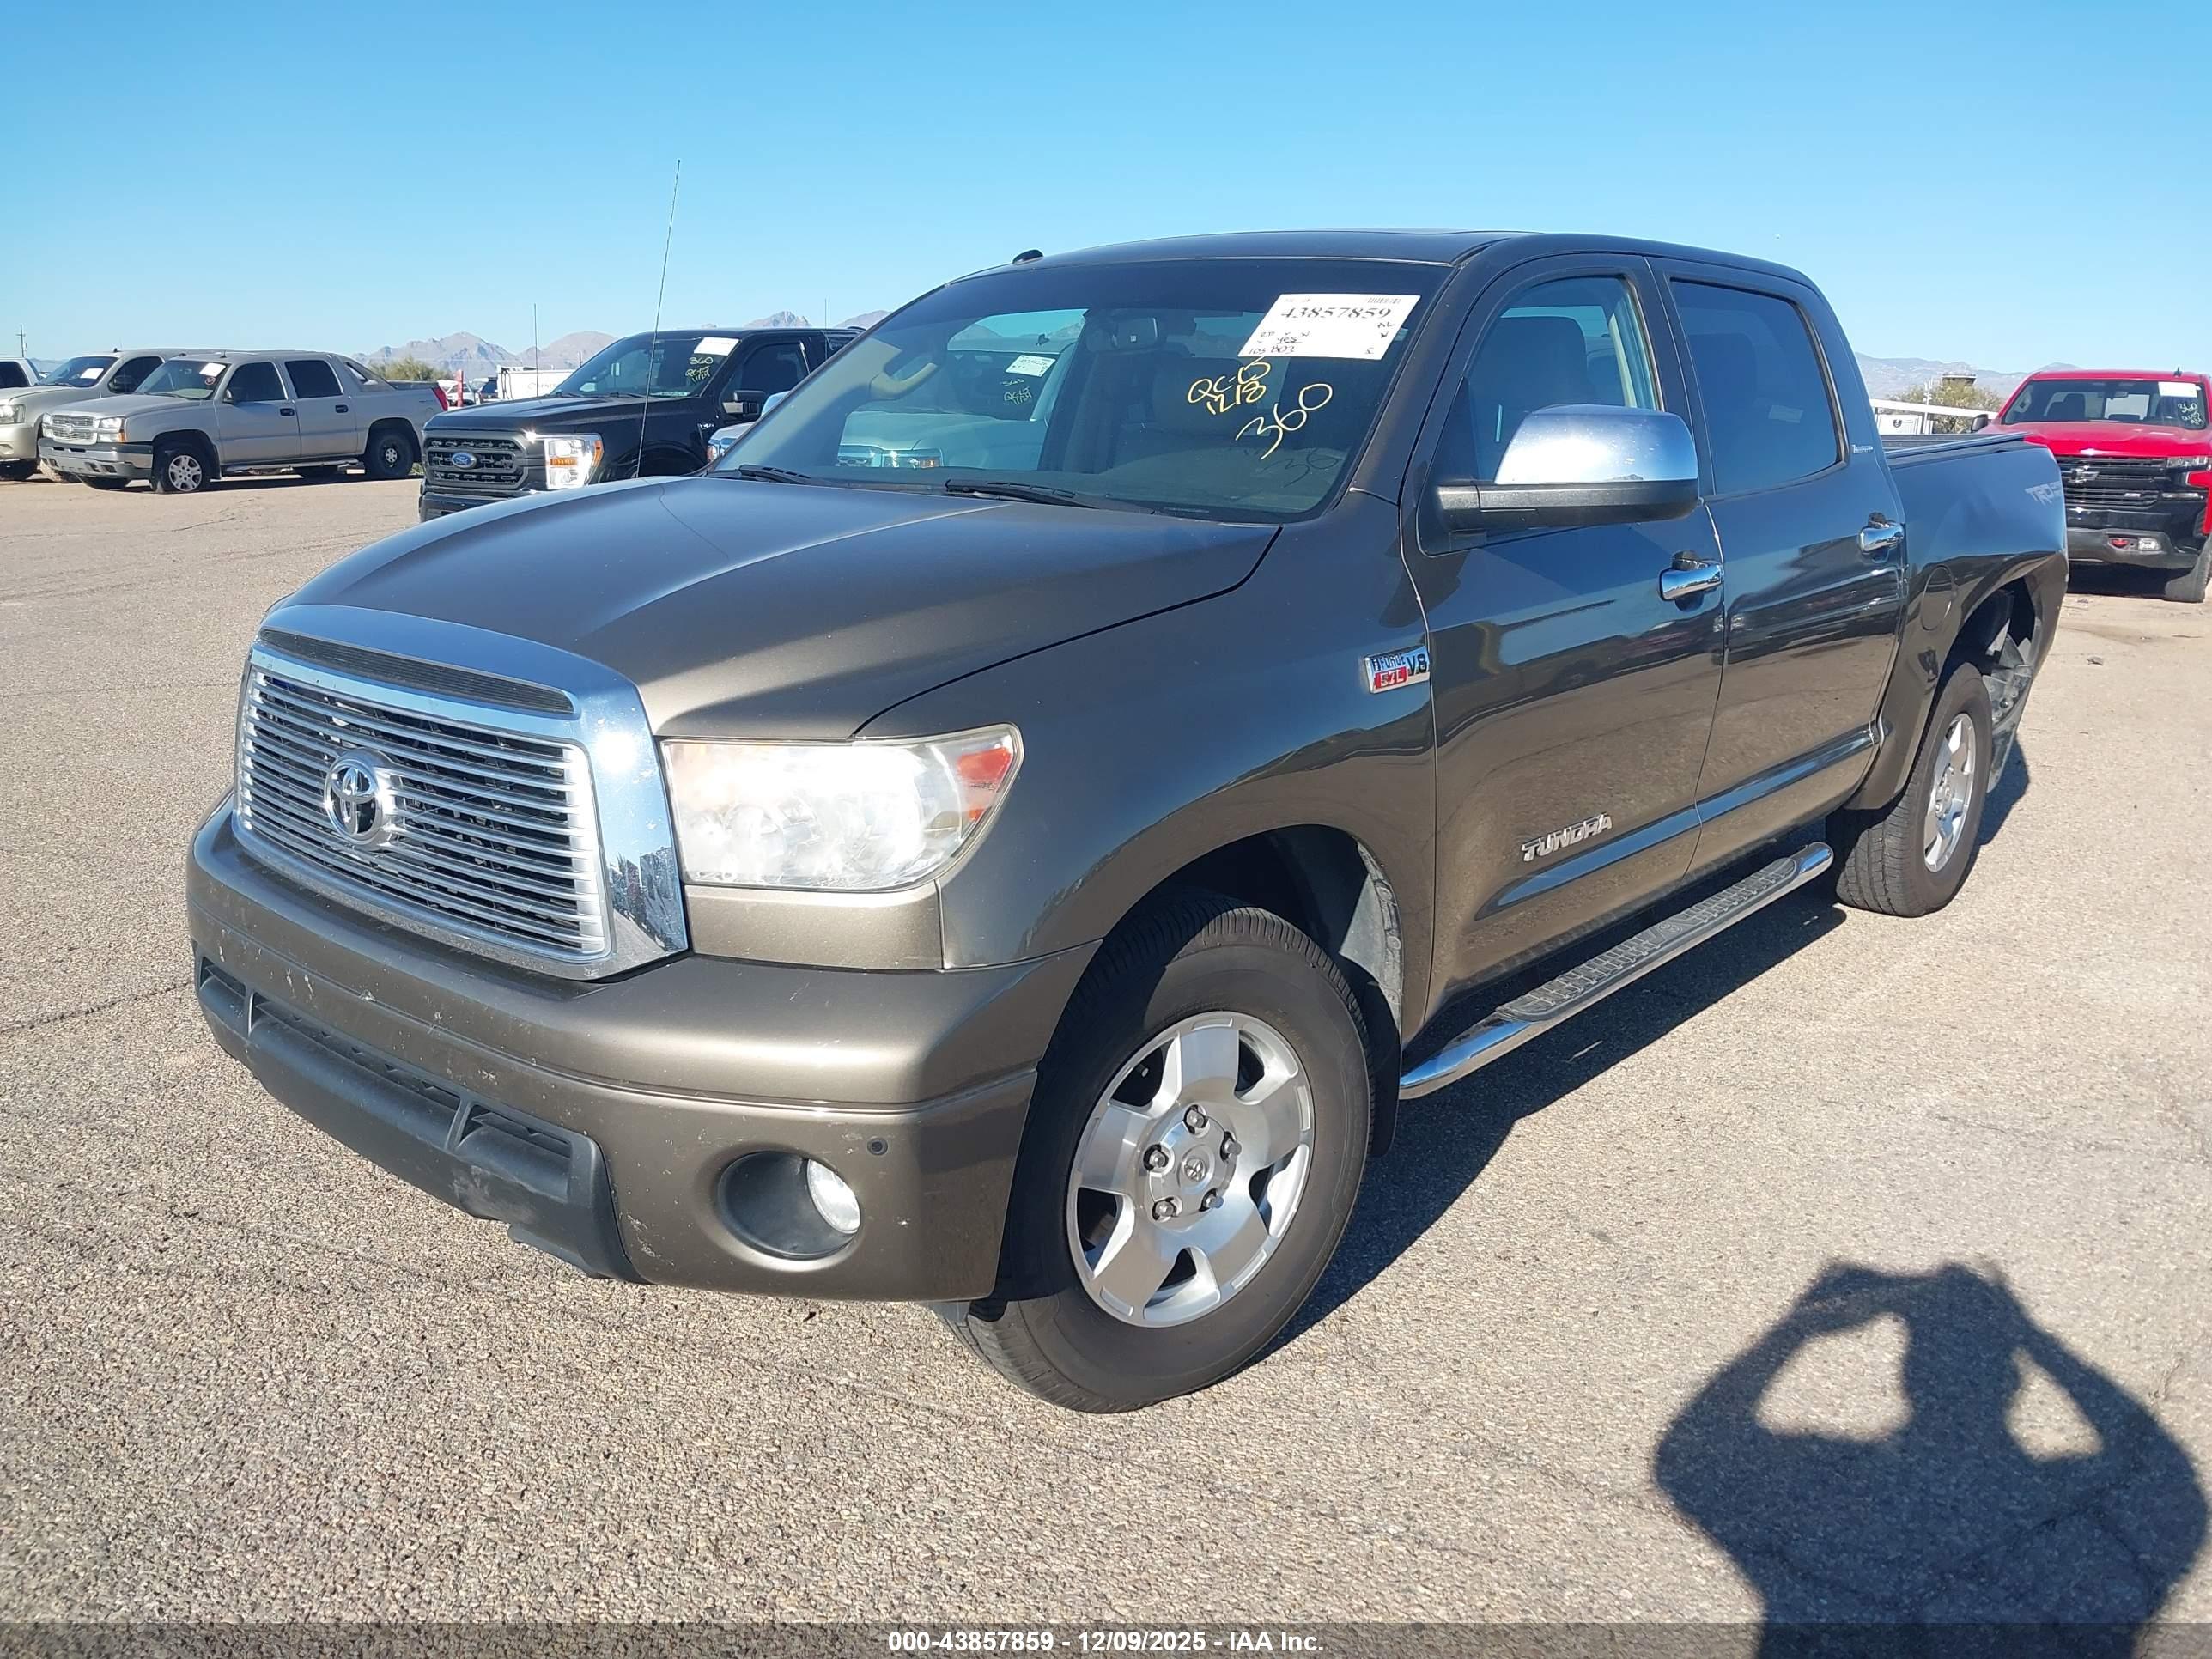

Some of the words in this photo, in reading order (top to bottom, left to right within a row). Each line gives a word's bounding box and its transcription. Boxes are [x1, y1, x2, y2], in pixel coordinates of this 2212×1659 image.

[1281, 307, 1392, 319] 43857859
[1235, 383, 1333, 460] 360
[1407, 653, 1427, 677] V8
[1521, 811, 1613, 862] TUNDRA
